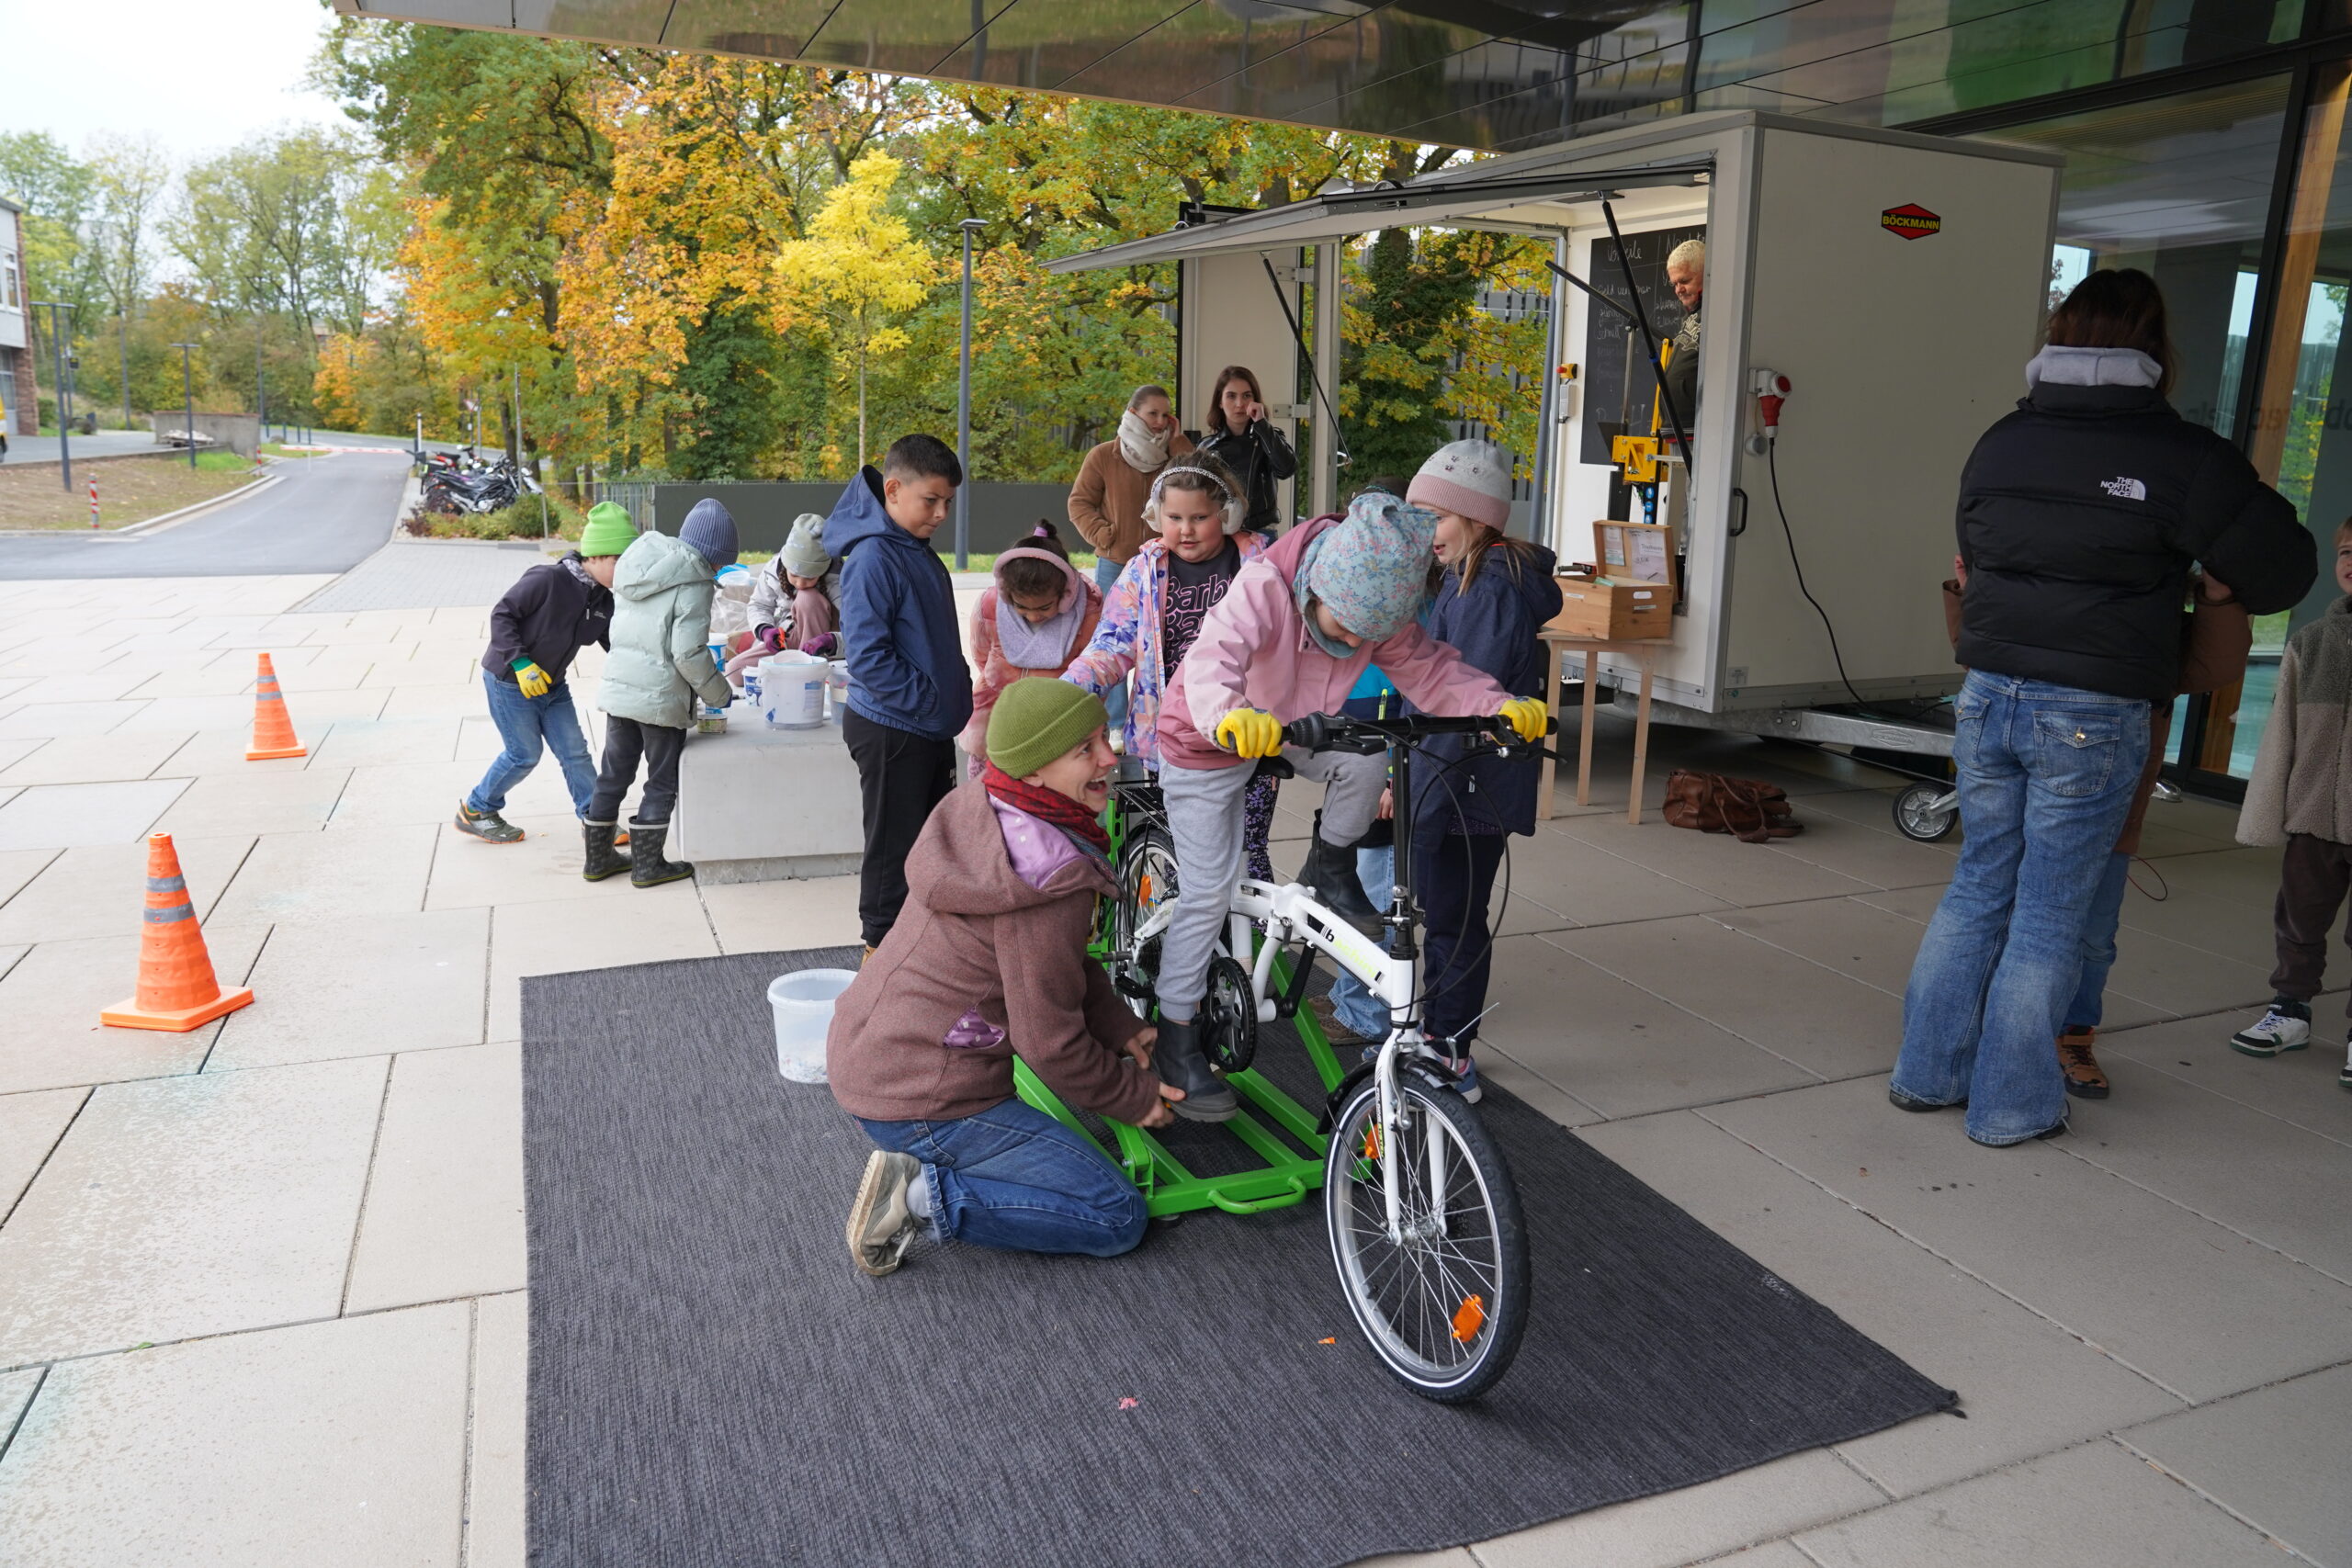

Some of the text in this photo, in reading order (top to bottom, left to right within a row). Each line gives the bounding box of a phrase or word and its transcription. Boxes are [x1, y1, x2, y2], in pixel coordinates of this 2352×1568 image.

[1883, 214, 1939, 229] BÖCKMANN
[2100, 480, 2132, 491] NORTH
[2116, 476, 2133, 485] THE
[2107, 488, 2131, 498] FACE
[1166, 574, 1232, 614] Barb
